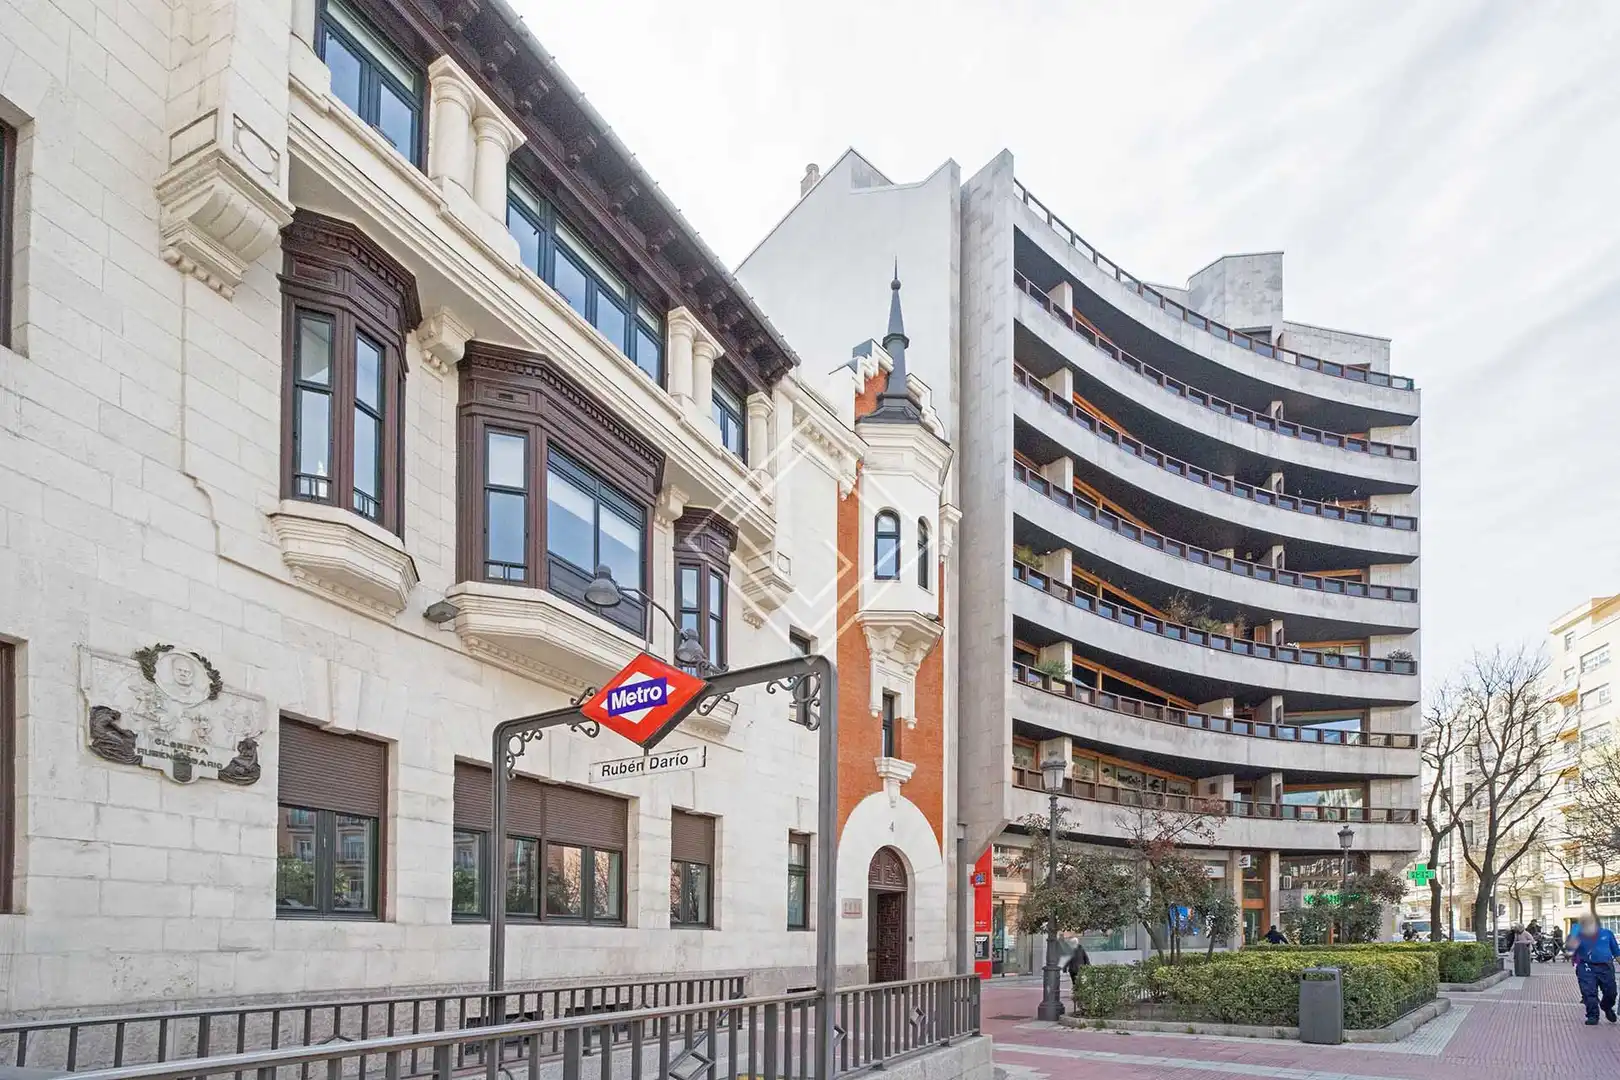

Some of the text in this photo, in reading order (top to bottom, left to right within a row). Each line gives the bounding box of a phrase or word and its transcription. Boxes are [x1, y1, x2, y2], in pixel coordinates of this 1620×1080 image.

[611, 685, 663, 711] Metro
[601, 753, 689, 777] Rubén Darío
